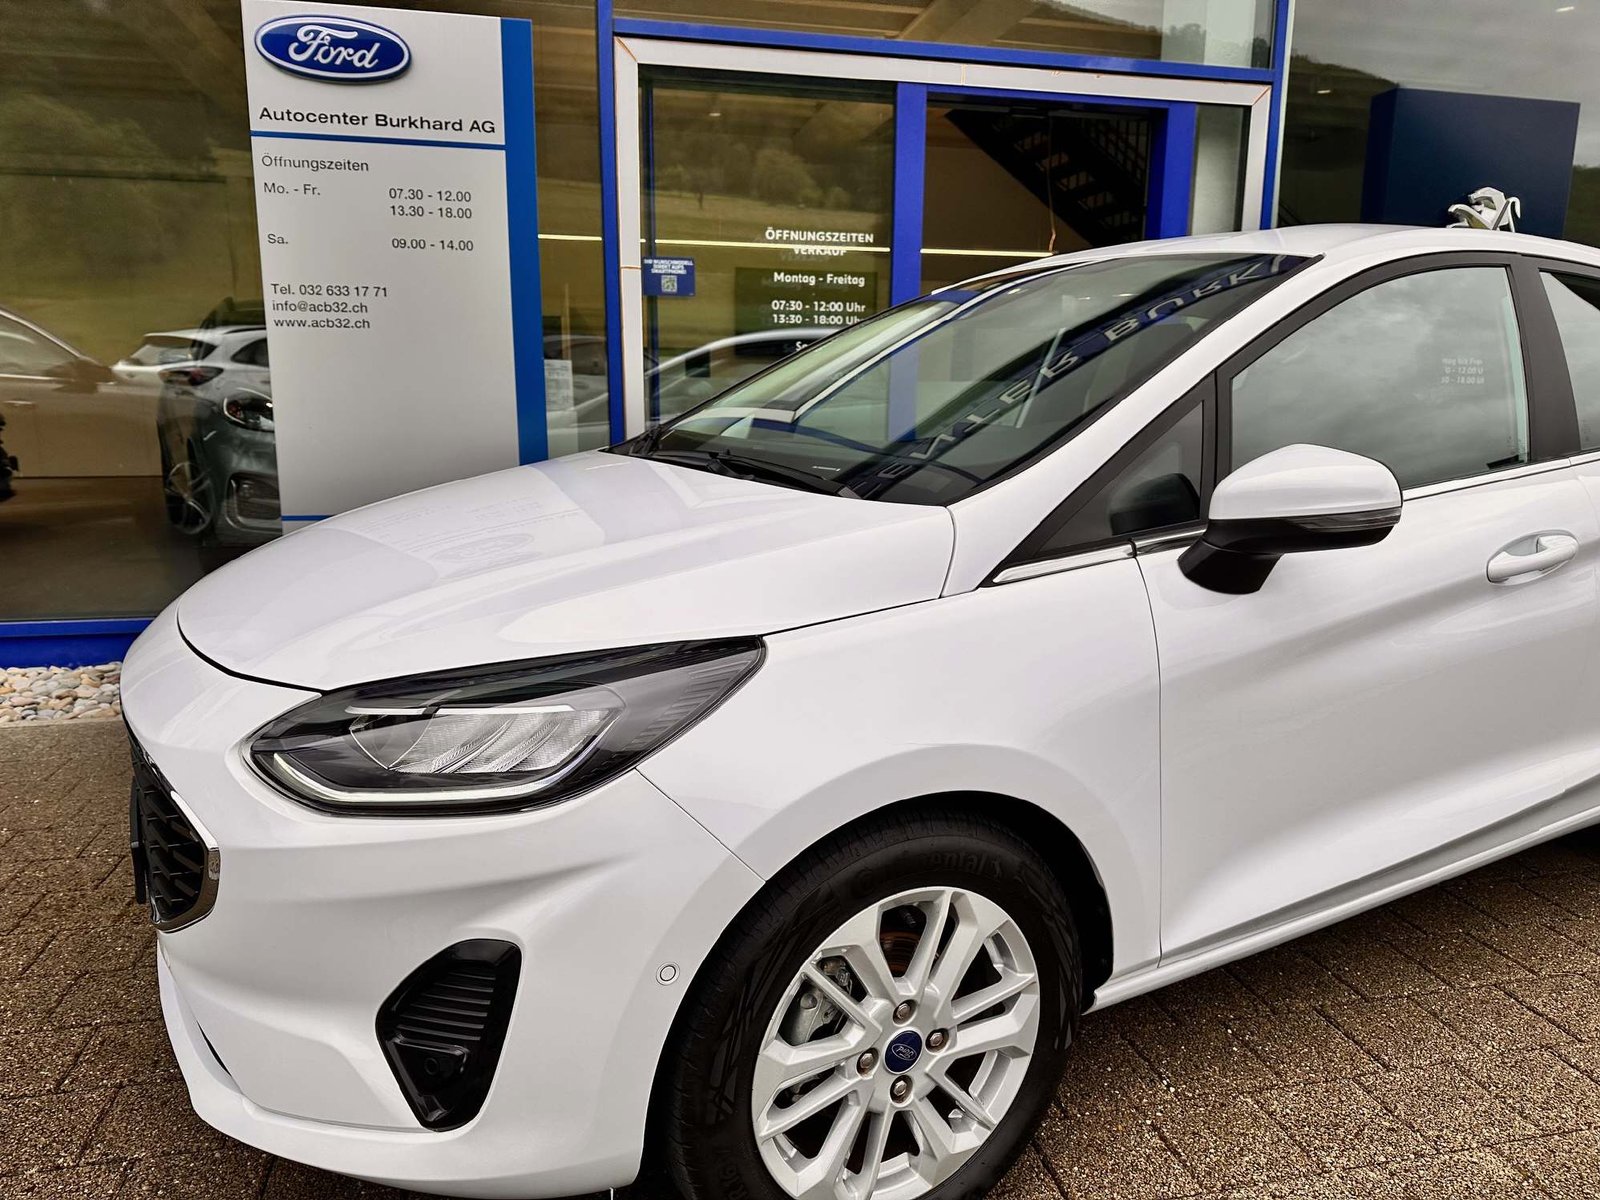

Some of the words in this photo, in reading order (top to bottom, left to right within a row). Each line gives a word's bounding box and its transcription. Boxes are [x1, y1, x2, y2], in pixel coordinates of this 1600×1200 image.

[288, 24, 381, 69] Ford
[259, 106, 368, 127] Autocenter
[374, 113, 463, 132] Burkhard
[469, 120, 496, 133] AG
[261, 152, 369, 172] Öffnungszeiten
[263, 182, 289, 194] Mo.
[303, 183, 321, 196] Fr.
[389, 187, 424, 200] 07.30
[436, 190, 472, 202] 12.00
[390, 205, 425, 217] 13.30
[437, 207, 472, 219] 18.00
[267, 232, 289, 245] Sa.
[765, 226, 874, 243] ÖFFNUNGSZEITEN
[391, 238, 426, 250] 09.00
[439, 239, 474, 251] 14.00
[773, 272, 816, 286] Montag
[826, 273, 866, 288] Freitag
[271, 283, 295, 295] Tel.
[299, 284, 323, 296] 032
[326, 285, 350, 297] 633
[354, 286, 369, 297] 17
[373, 286, 388, 297] 71
[272, 299, 368, 313] info@acb32.ch
[771, 300, 803, 311] 07:30
[813, 301, 844, 312] 12:00
[846, 302, 866, 313] Uhr
[273, 318, 371, 329] www.acb32.ch
[772, 313, 803, 324] 13:30
[813, 315, 844, 325] 18:00
